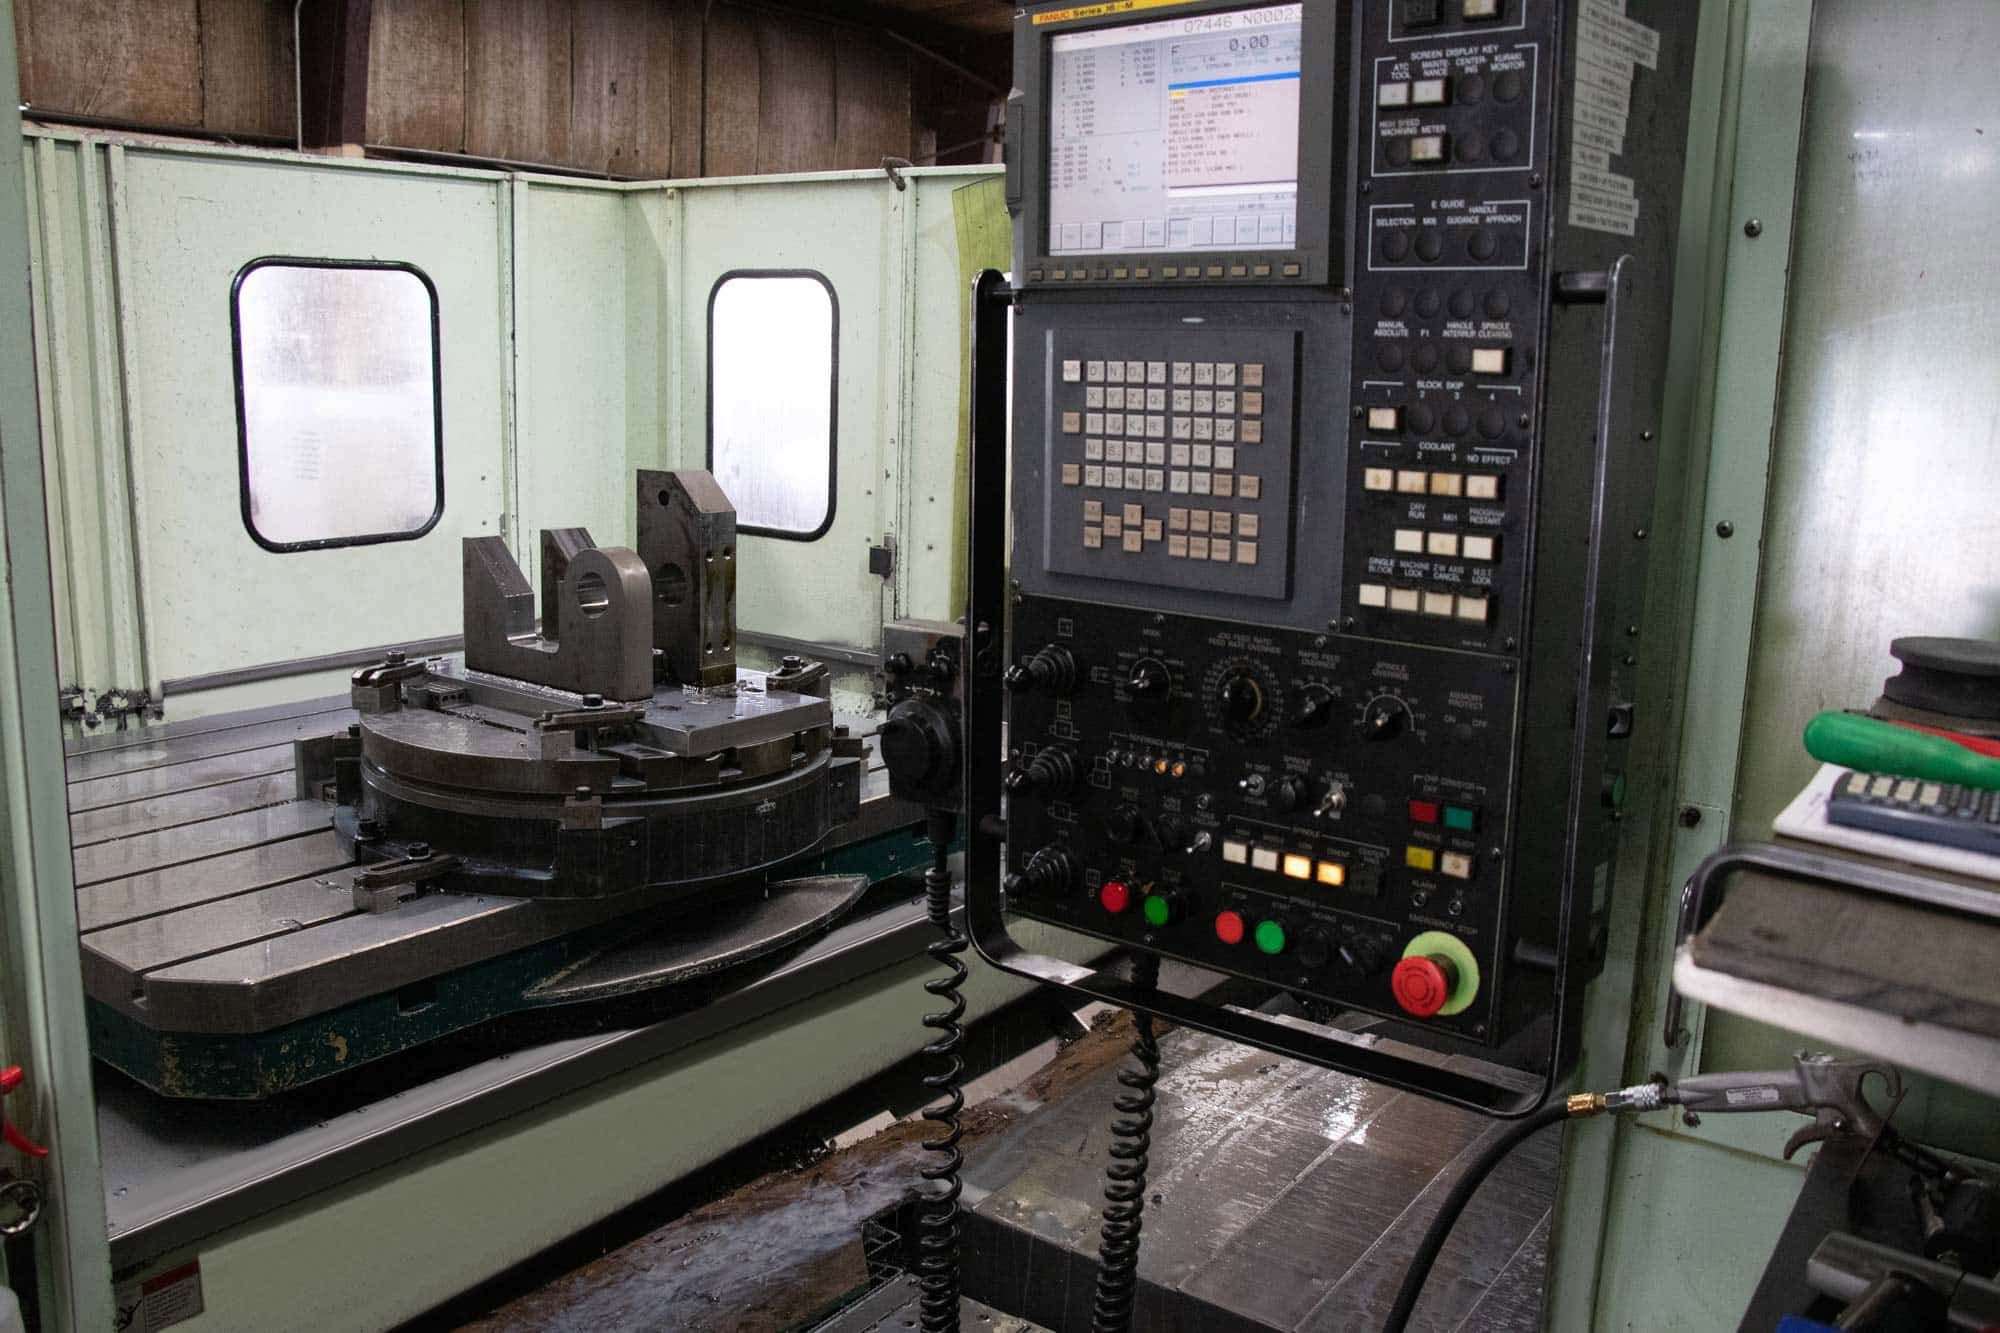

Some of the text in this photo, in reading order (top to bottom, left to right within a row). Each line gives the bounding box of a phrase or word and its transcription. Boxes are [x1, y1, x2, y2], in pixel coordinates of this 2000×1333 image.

[1040, 10, 1069, 21] FANUC
[1073, 7, 1102, 18] Series
[1229, 34, 1269, 51] 0.00
[1411, 44, 1499, 61] SCREEN DISPLAY KEY
[1393, 63, 1409, 72] ATC
[1491, 61, 1525, 72] MONITOR
[1391, 72, 1411, 80] TOOL
[1423, 68, 1448, 77] NANCE
[1379, 118, 1420, 129] HIGH SPEED
[1380, 126, 1417, 136] MACHINING
[1421, 124, 1446, 134] METER
[1439, 199, 1465, 209] GUIDE
[1469, 205, 1497, 214] HANDLE
[1376, 218, 1416, 227] SELECTION
[1446, 216, 1479, 225] GUIDANCE
[1485, 215, 1522, 224] APPROACH
[1377, 321, 1405, 329] MANUAL
[1446, 321, 1474, 329] HANDLE
[1481, 321, 1511, 330] SPINDLE
[1373, 329, 1409, 337] ABSOLUTE
[1478, 330, 1513, 339] CLEANING
[1416, 380, 1464, 391] BLOCK SKIP
[1418, 442, 1456, 451] COOLANT
[1467, 454, 1512, 465] NO EFFECT
[1410, 503, 1426, 512] DRY
[1408, 511, 1425, 520] RUN
[1469, 508, 1505, 518] PROGRAM
[1468, 516, 1502, 525] RESTART
[1368, 557, 1395, 566] SINGLE
[1400, 560, 1431, 570] MACHINE
[1368, 565, 1393, 575] BLOCK
[1404, 569, 1423, 578] LOCK
[1433, 572, 1461, 582] CANCEL
[1471, 576, 1492, 586] LOCK
[1208, 636, 1281, 654] FEED RATE OVERRIDE
[1298, 649, 1341, 663] RAPID FEED
[1301, 658, 1336, 670] OVERRIDE
[1376, 661, 1407, 672] SPINDLE
[1371, 668, 1410, 681] OVERRIDE
[1449, 691, 1483, 702] MEMORY
[1448, 698, 1484, 711] PROTECT
[1444, 714, 1488, 728] ON OFF
[1408, 913, 1479, 935] EMERGENCY STOP
